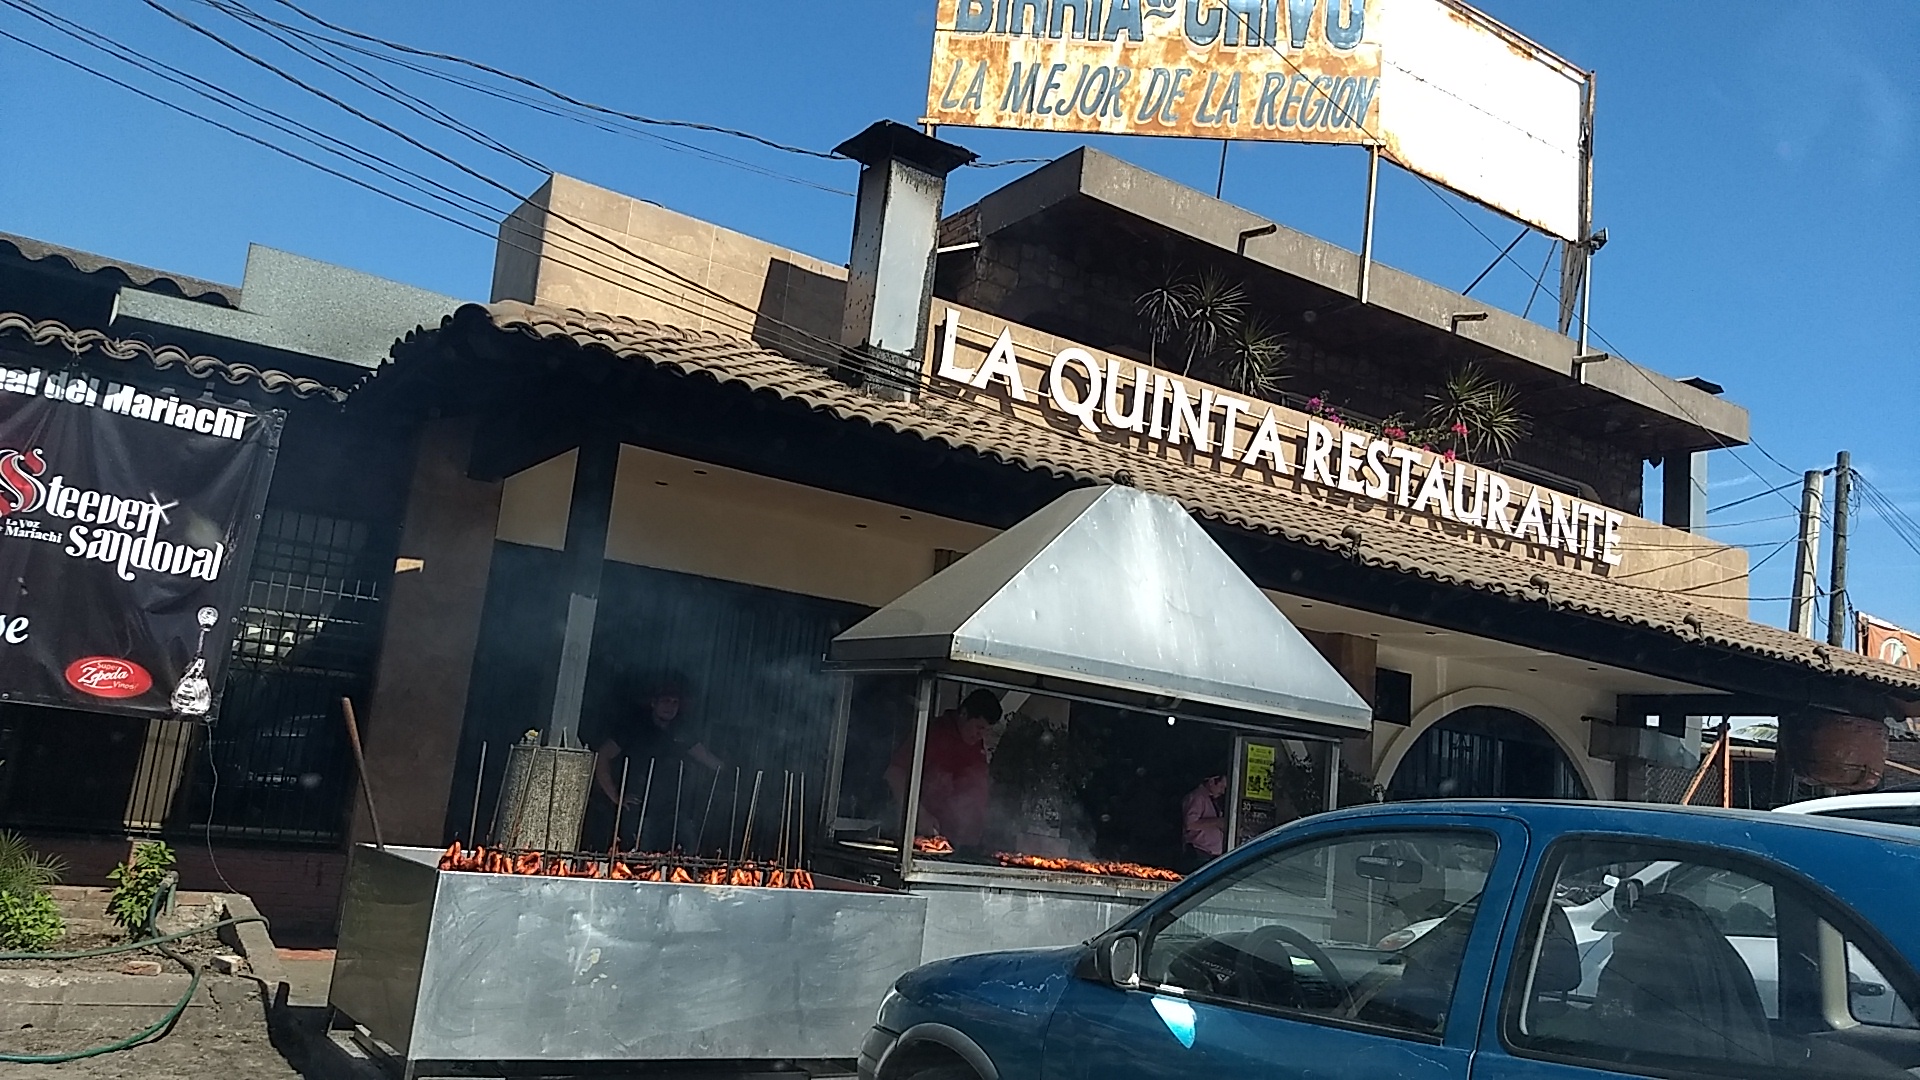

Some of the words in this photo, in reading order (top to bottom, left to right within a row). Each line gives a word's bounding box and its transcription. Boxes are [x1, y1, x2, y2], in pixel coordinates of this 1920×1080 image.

[940, 59, 988, 110] LA
[1000, 61, 1132, 118] MEJOR
[1137, 67, 1192, 122] DE
[1195, 71, 1241, 124] LA
[1254, 71, 1378, 129] REGION
[44, 371, 100, 407] del
[102, 381, 248, 440] Mariachi
[938, 307, 1029, 402] LA
[1050, 347, 1290, 475] QUINTA
[1302, 419, 1624, 567] RESTAURANTE
[4, 525, 63, 544] Mariachi
